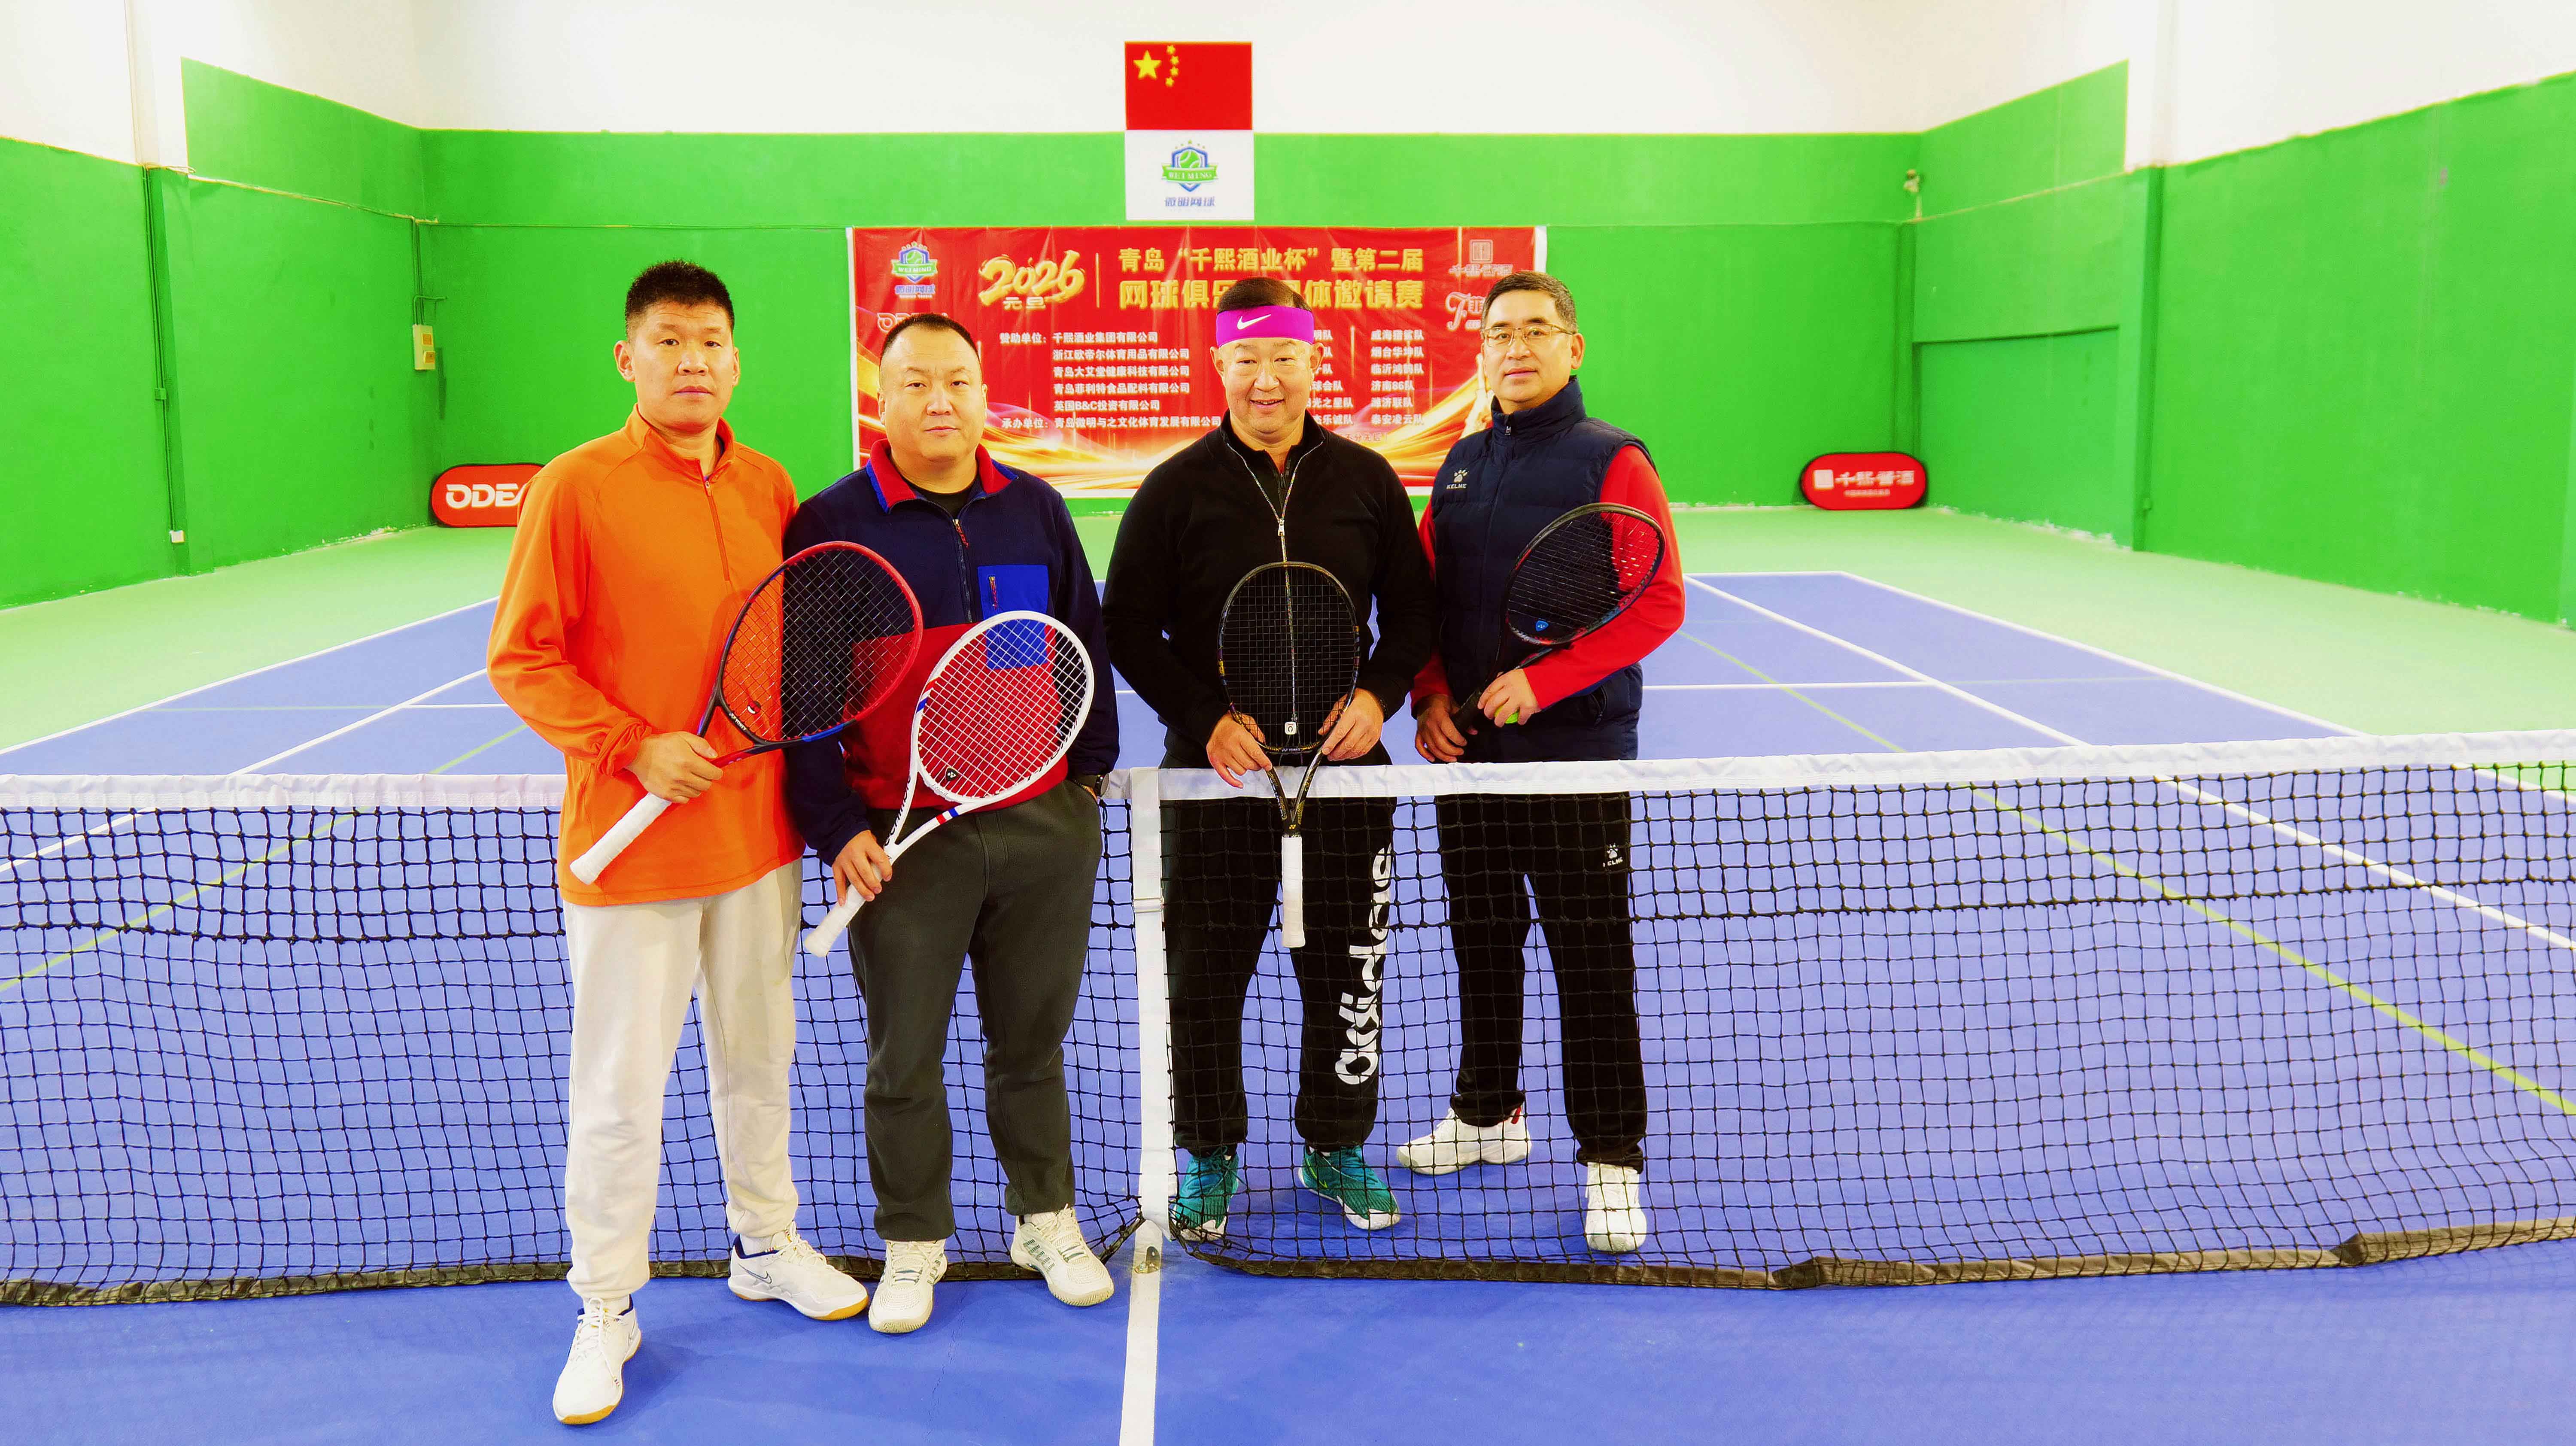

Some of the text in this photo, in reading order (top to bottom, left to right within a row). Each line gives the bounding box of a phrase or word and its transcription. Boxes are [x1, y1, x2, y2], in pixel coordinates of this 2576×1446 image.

[978, 250, 1085, 306] 2026
[1119, 279, 1423, 309] 网球俱乐体邀请赛
[1003, 296, 1046, 310] 元旦
[999, 331, 1158, 344] 赞助单位： 千熙酒业集团有限公司
[1053, 348, 1189, 361] 浙江欧帝尔体育用品有限公司
[1054, 382, 1190, 395] 青岛菲利特食品配料有限公司
[1371, 380, 1415, 392] 济南86队
[1054, 399, 1160, 411] 英国B&C投资有限公司
[1002, 417, 1048, 429] 承办单位：
